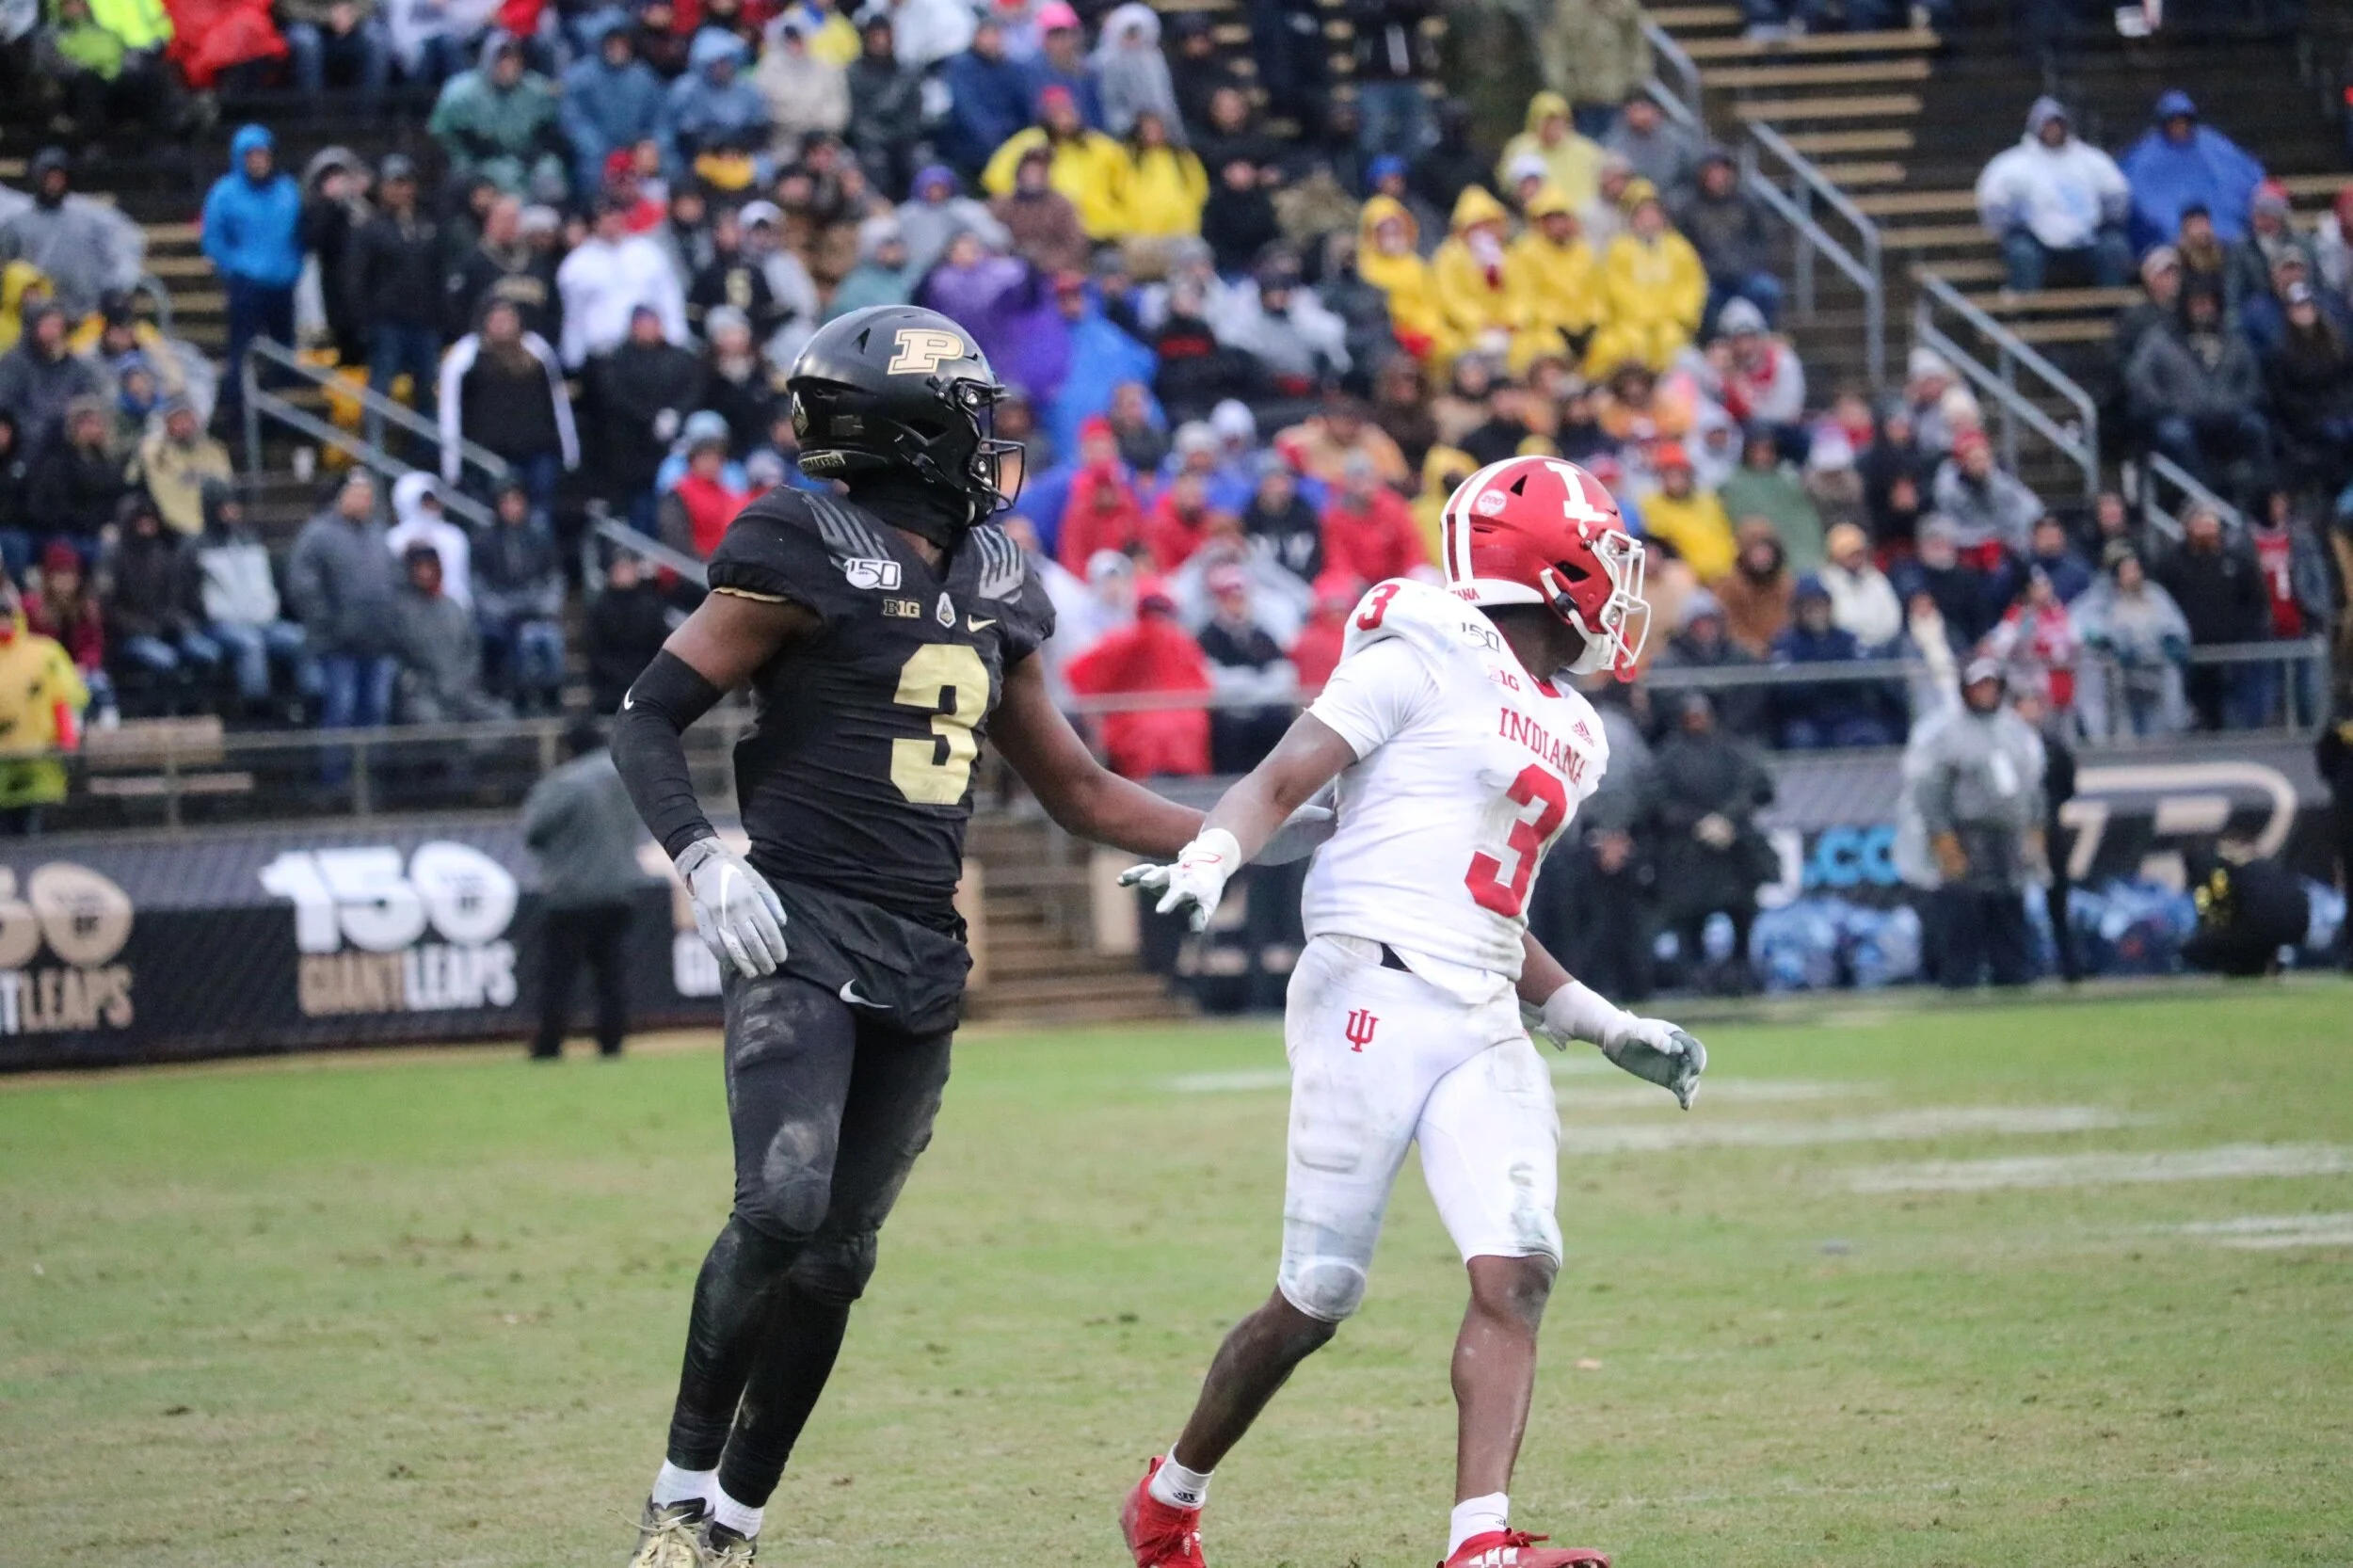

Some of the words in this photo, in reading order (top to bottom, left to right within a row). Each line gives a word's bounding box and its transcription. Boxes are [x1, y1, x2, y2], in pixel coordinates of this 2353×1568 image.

[888, 328, 964, 375] P
[847, 558, 901, 589] 150
[883, 599, 921, 618] BIG
[1356, 584, 1401, 632] 3
[1461, 622, 1501, 653] 150
[890, 644, 989, 805] 3
[1498, 707, 1586, 789] INDIANA
[1465, 763, 1567, 919] 3
[258, 840, 517, 953] 150
